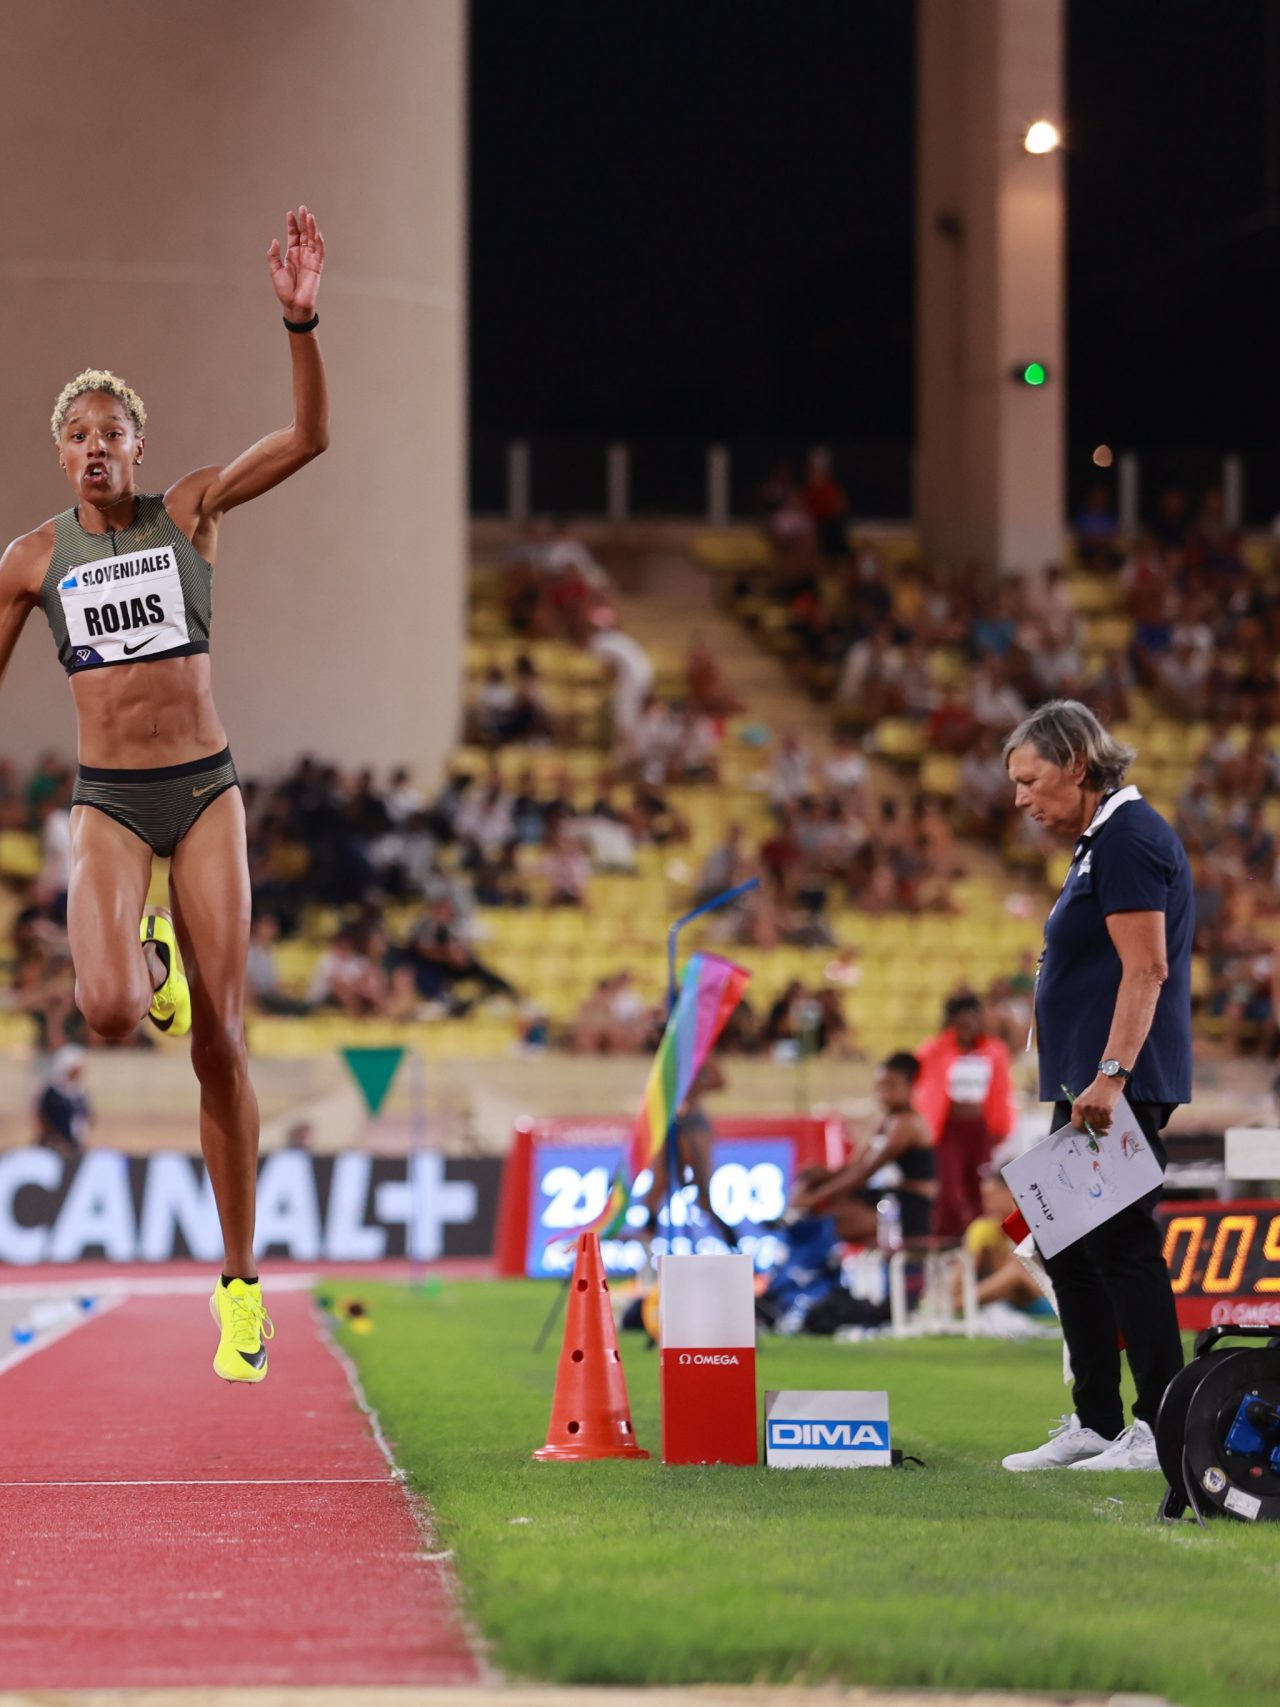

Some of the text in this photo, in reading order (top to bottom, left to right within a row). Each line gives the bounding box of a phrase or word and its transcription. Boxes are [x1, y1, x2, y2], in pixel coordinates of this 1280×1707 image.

[84, 594, 165, 637] ROJAS
[693, 1354, 739, 1365] OMEGA
[772, 1424, 883, 1446] DIMA
